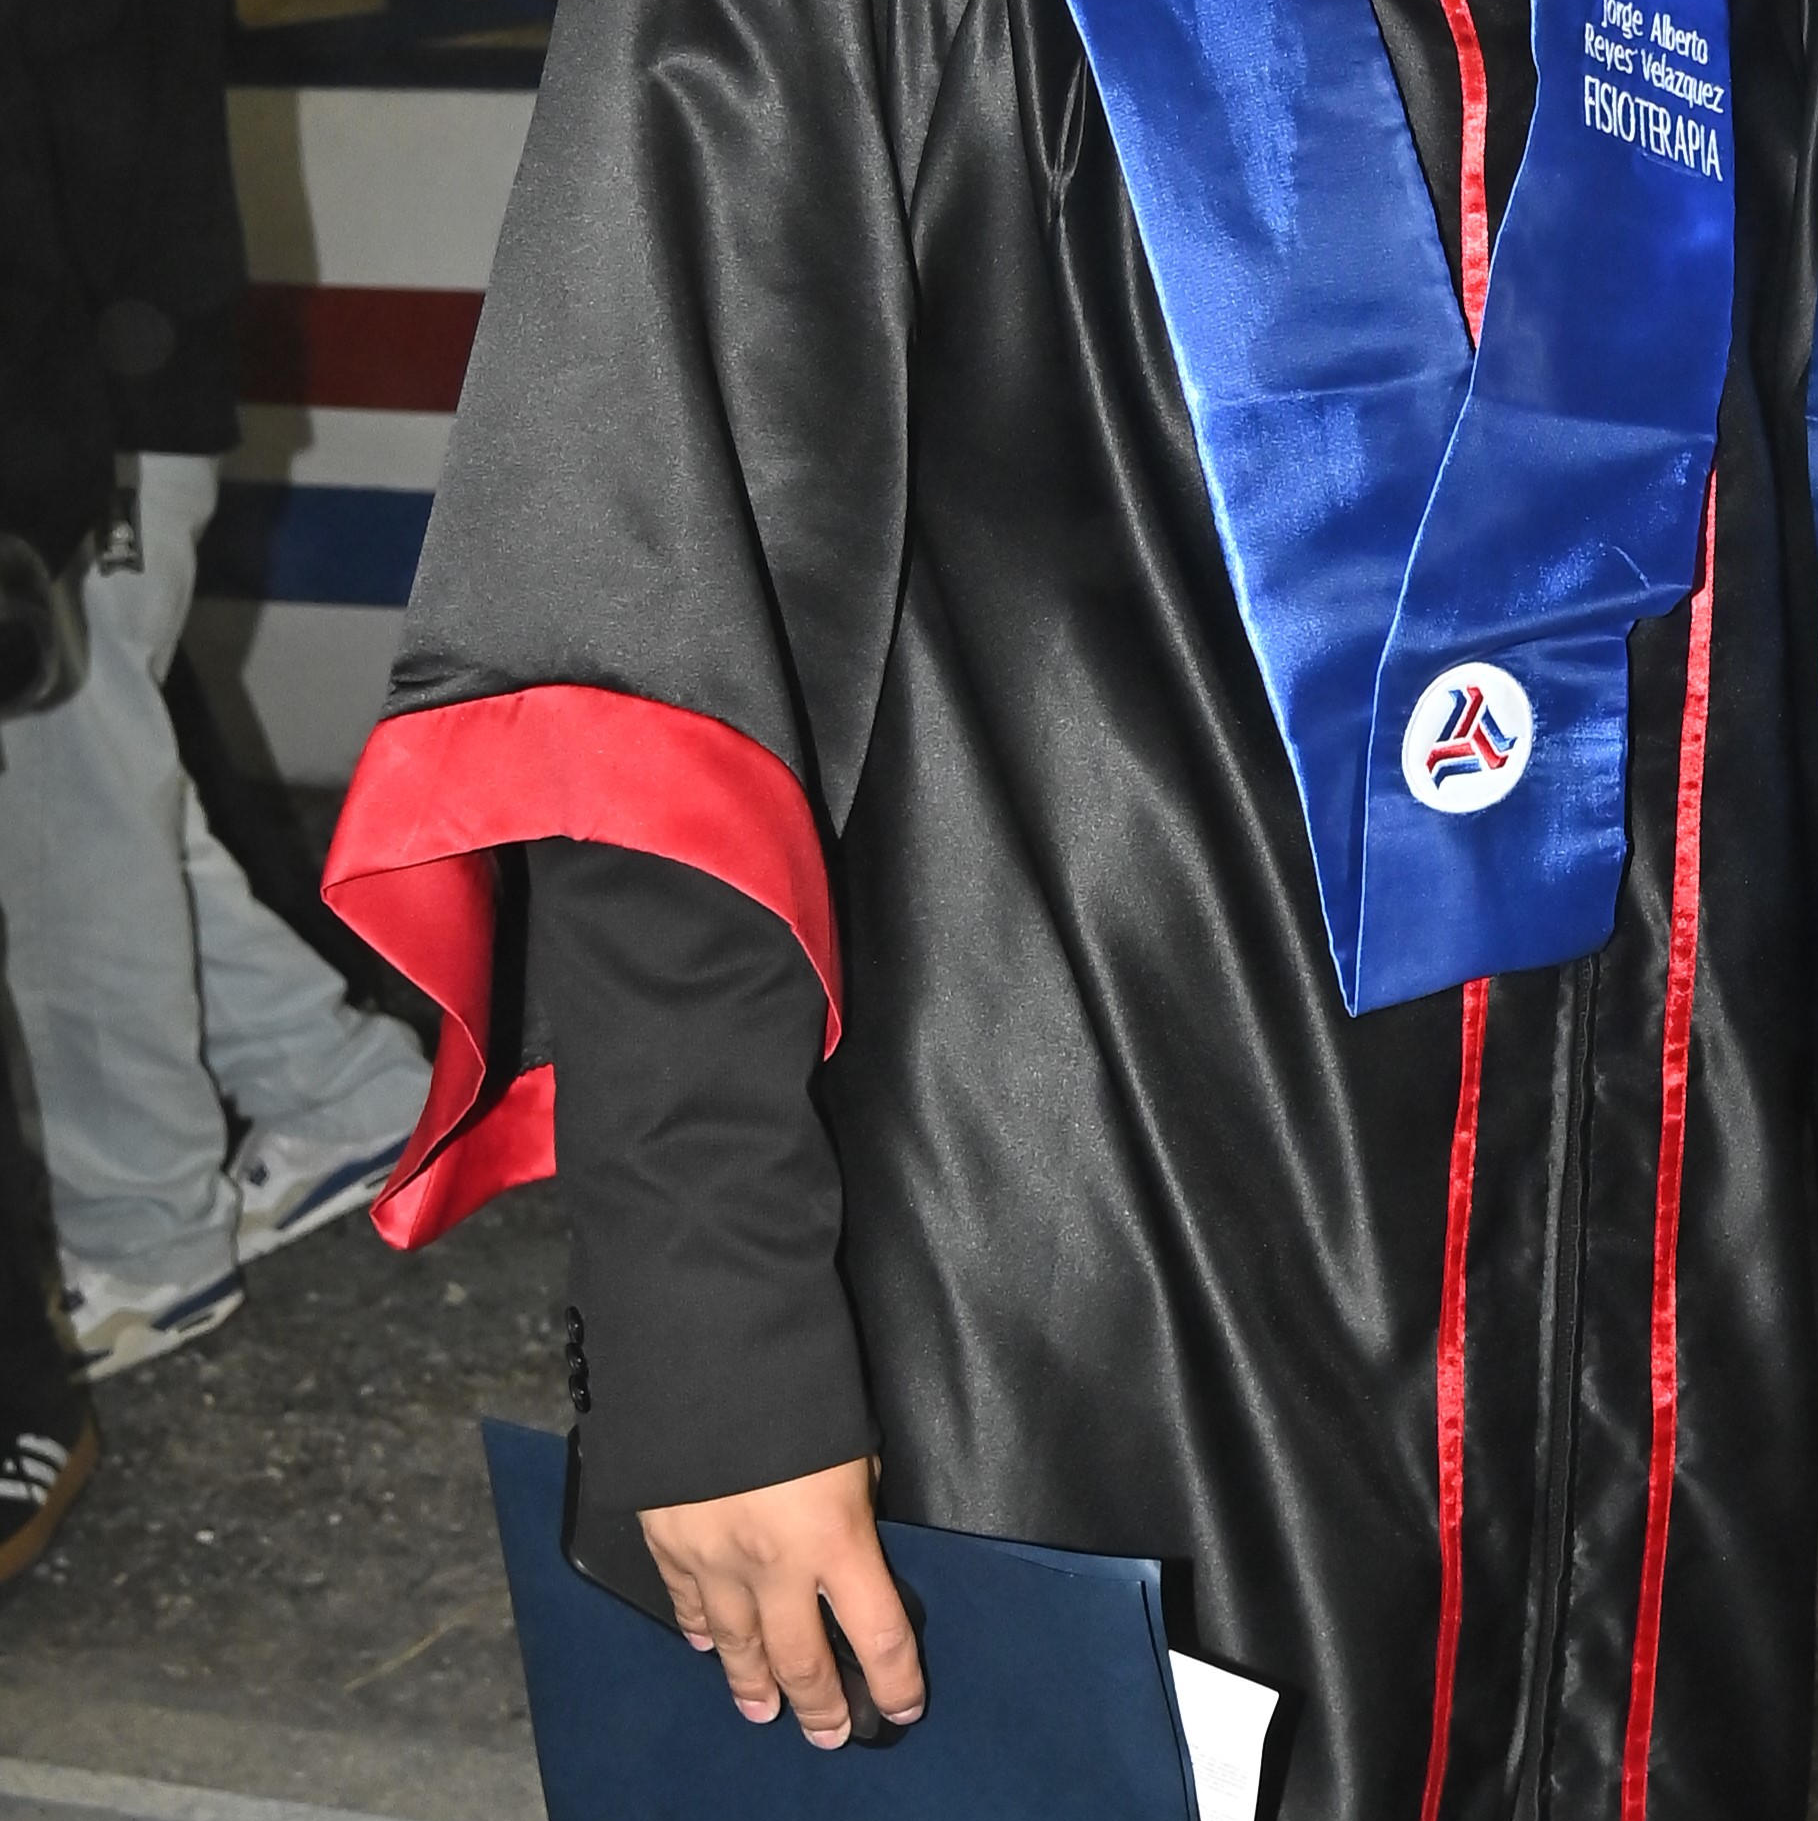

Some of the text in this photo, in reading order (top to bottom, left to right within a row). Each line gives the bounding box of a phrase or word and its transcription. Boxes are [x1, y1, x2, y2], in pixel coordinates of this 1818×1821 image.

[1584, 23, 1725, 113] Reyes Velazquez
[1650, 12, 1708, 65] Alberto
[1584, 75, 1723, 181] FISIOTERAPIA
